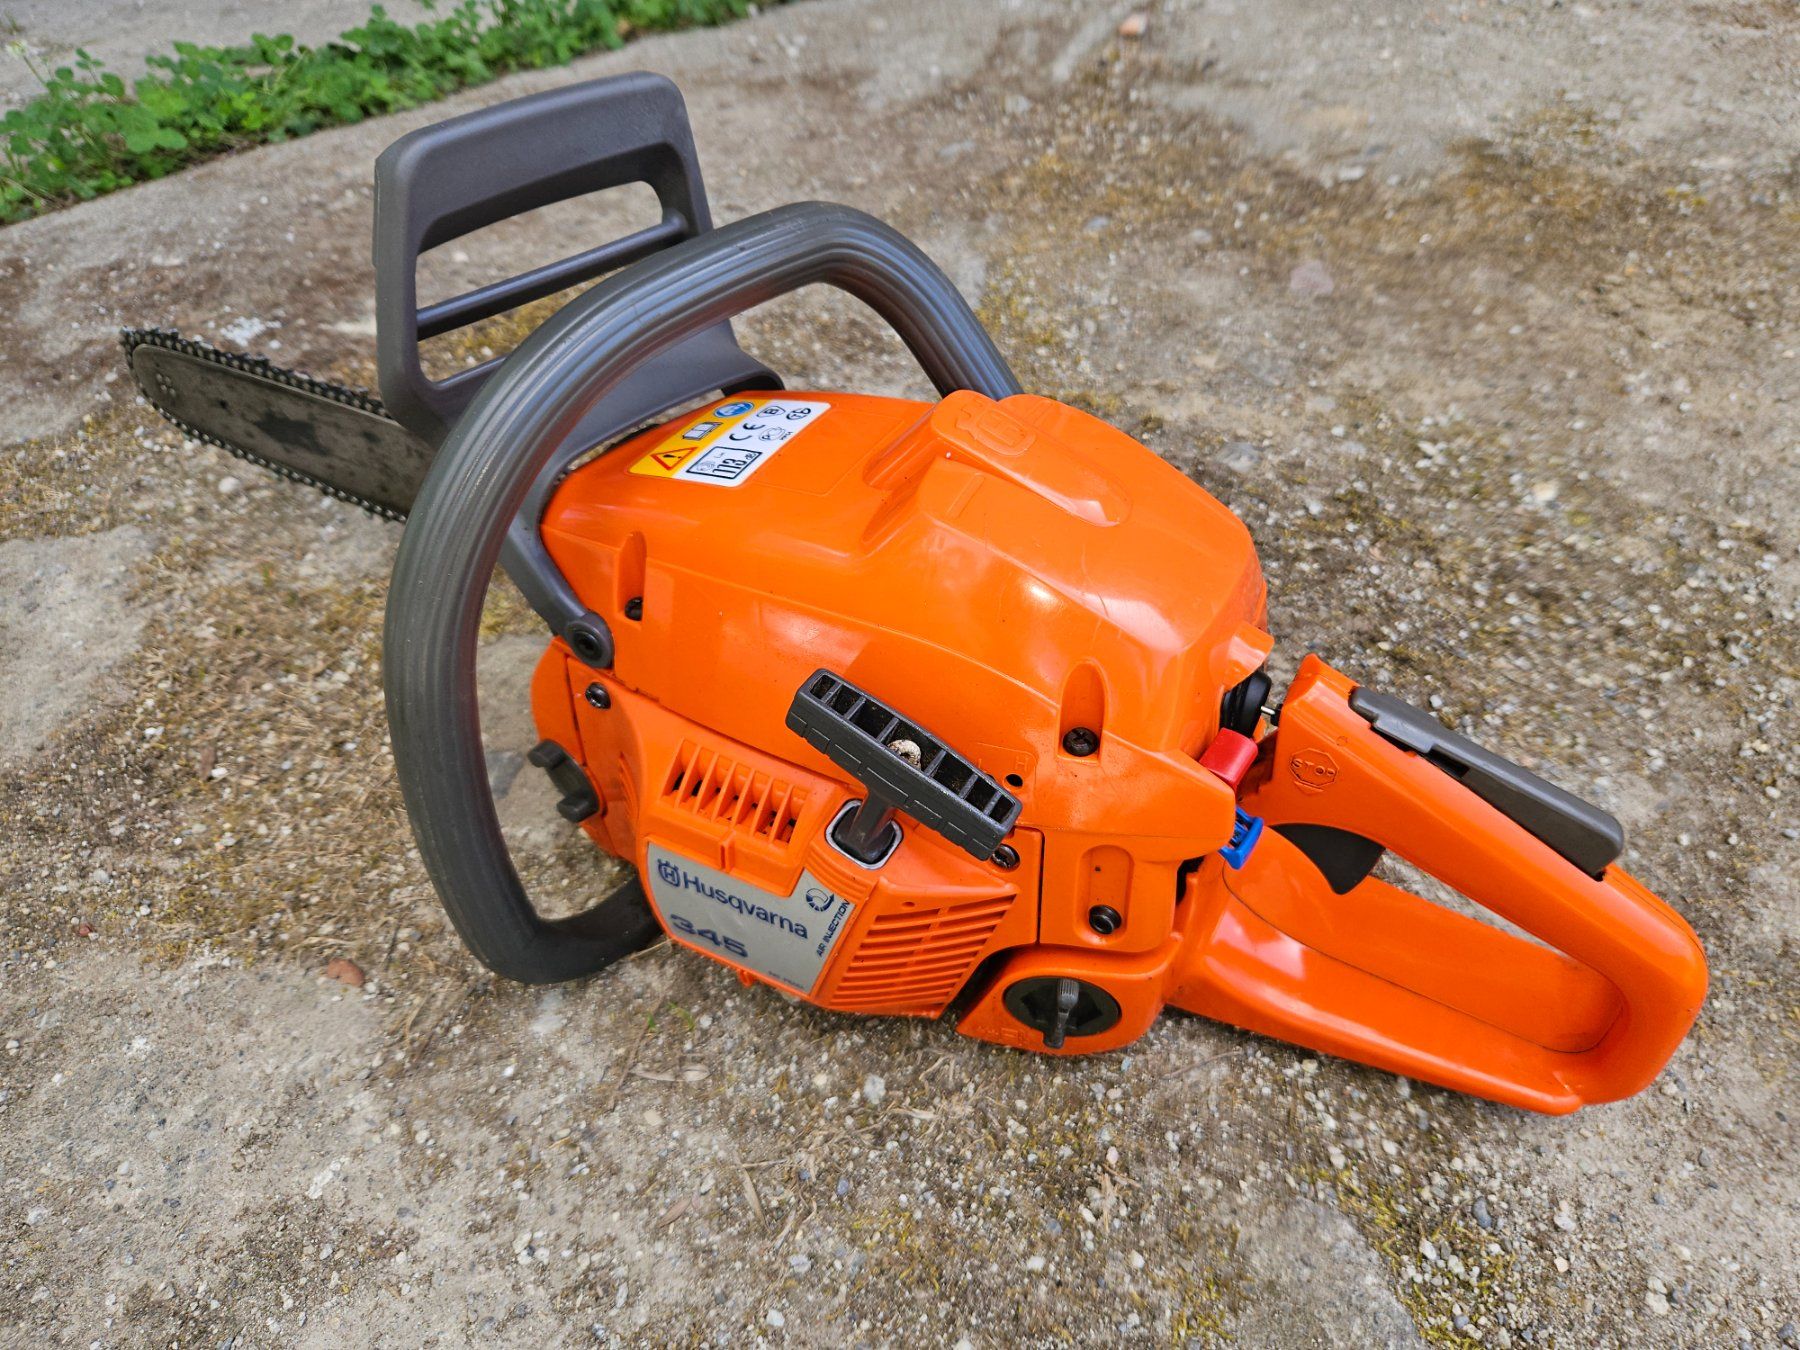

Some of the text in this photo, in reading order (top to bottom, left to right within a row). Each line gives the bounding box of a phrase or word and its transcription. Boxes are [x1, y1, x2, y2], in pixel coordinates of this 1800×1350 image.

[712, 458, 747, 474] 113
[1291, 758, 1336, 778] STOP
[683, 871, 808, 939] Husqvarna
[670, 913, 749, 958] 345
[816, 898, 850, 958] AIR INJECTION
